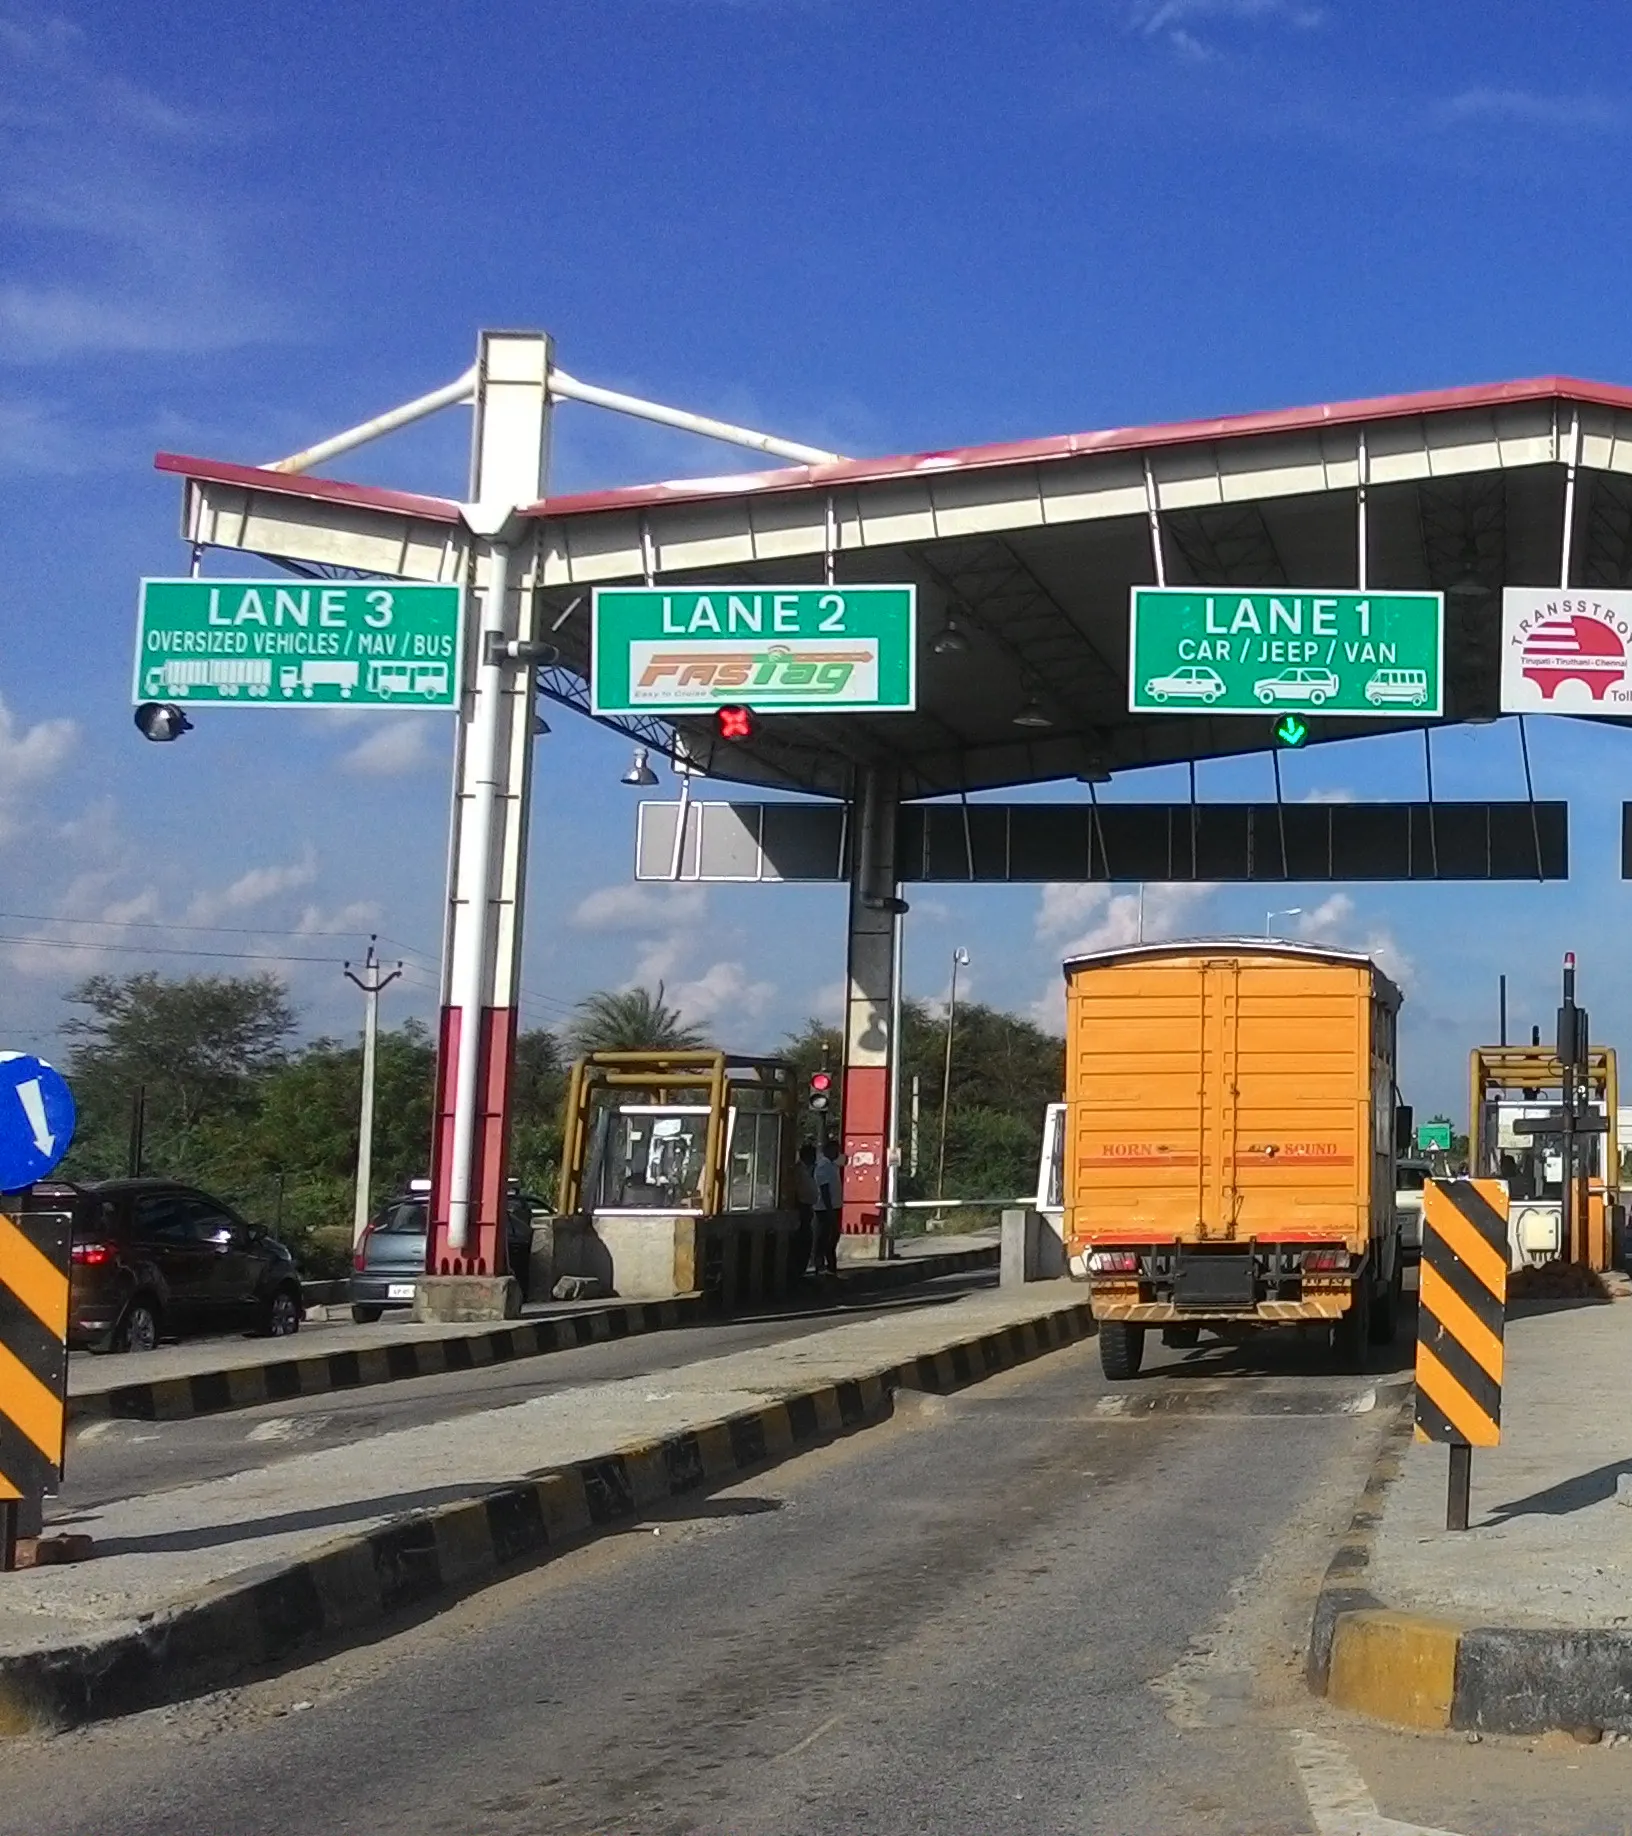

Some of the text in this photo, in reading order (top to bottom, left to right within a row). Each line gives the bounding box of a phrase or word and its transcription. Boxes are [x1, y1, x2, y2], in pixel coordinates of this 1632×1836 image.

[208, 587, 395, 628] LANE 3
[662, 594, 846, 633] LANE 2
[1206, 598, 1373, 637] LANE 1
[147, 629, 247, 653] OVERSIZED
[254, 632, 339, 655] VEHICLES
[358, 634, 397, 655] MAV
[413, 634, 453, 656] BUS
[1178, 639, 1231, 661] CAR
[1257, 640, 1319, 663] JEEP
[1345, 641, 1397, 663] VAN
[1521, 657, 1551, 666] Tirupati
[1556, 658, 1591, 666] Tiruthani
[1595, 659, 1628, 667] Chennai
[1102, 1143, 1153, 1156] HORN
[1284, 1143, 1338, 1156] SOUND
